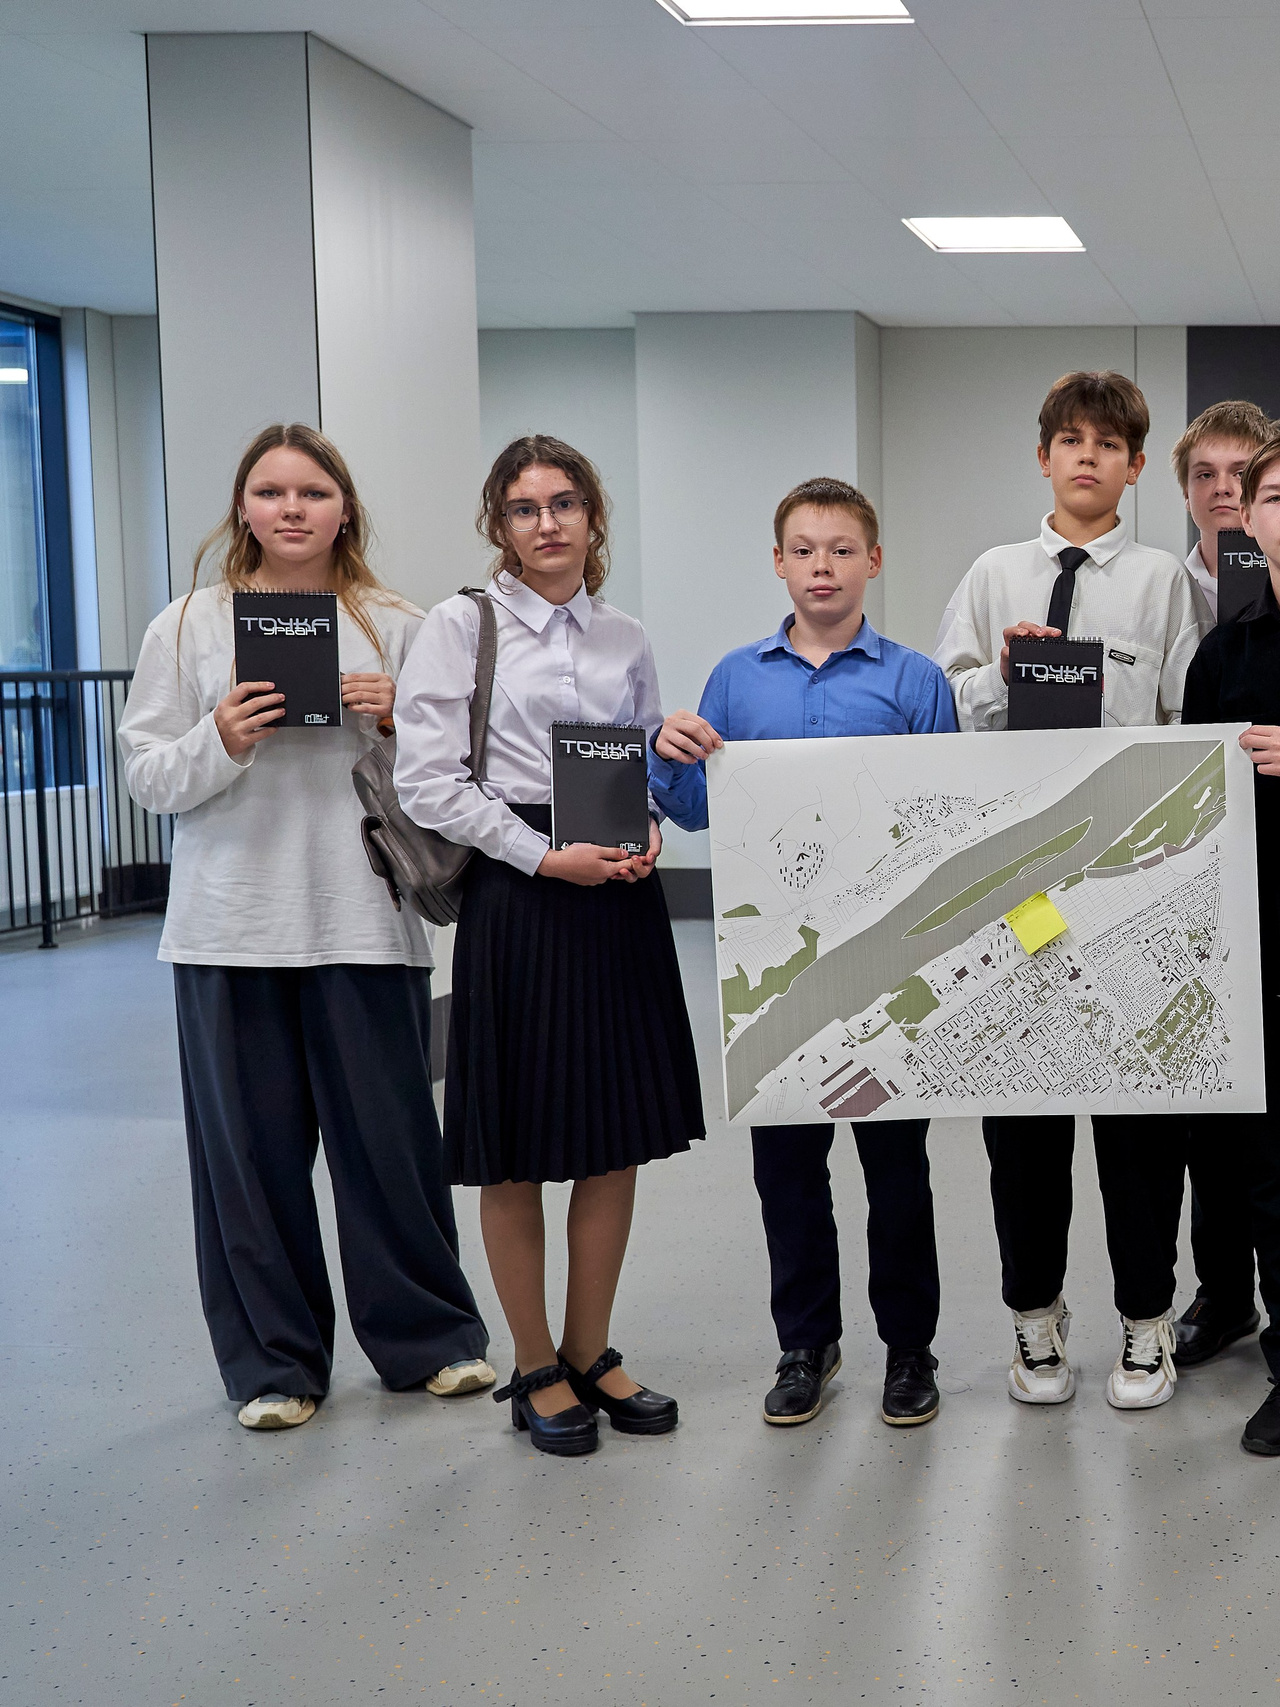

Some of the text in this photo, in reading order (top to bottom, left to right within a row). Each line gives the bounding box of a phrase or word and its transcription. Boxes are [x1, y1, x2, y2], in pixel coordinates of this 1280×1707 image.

[1223, 551, 1267, 566] ТОЧ
[1242, 560, 1268, 569] УРБ
[239, 617, 330, 633] ТОЧКА
[1015, 663, 1098, 681] ТОЧКА
[559, 740, 642, 758] ТОЧКА
